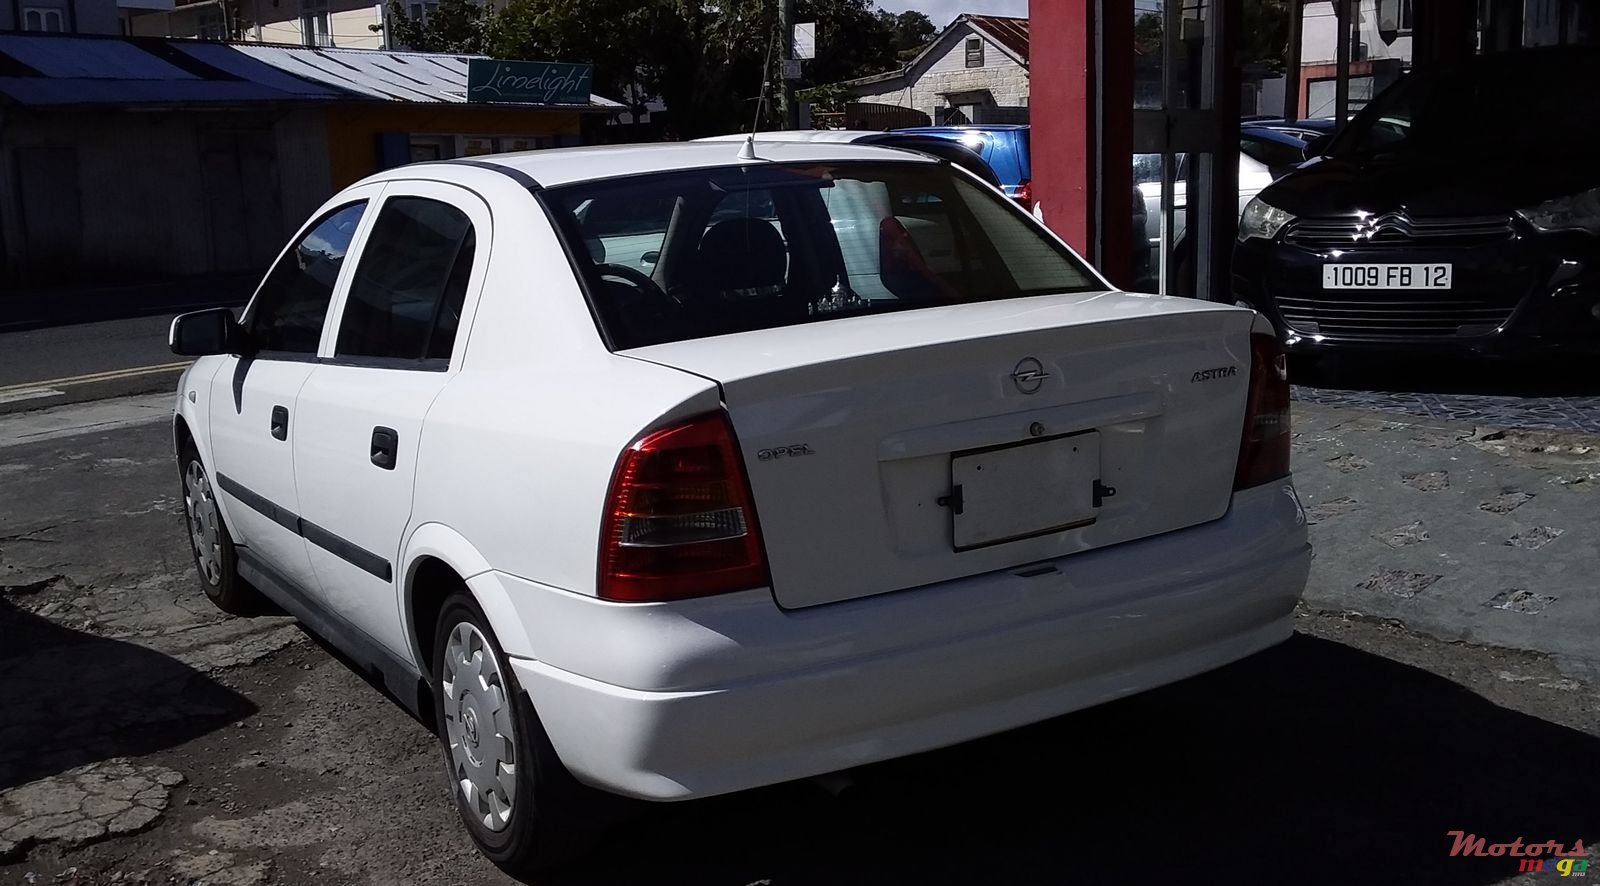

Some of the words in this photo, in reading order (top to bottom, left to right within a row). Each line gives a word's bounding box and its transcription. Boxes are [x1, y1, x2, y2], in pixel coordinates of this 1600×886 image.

[472, 64, 589, 101] Limelight
[1333, 266, 1378, 286] 1009
[1386, 266, 1411, 286] FB
[1424, 266, 1446, 286] 12
[1190, 366, 1237, 383] ASTRA
[757, 443, 816, 462] OPEL
